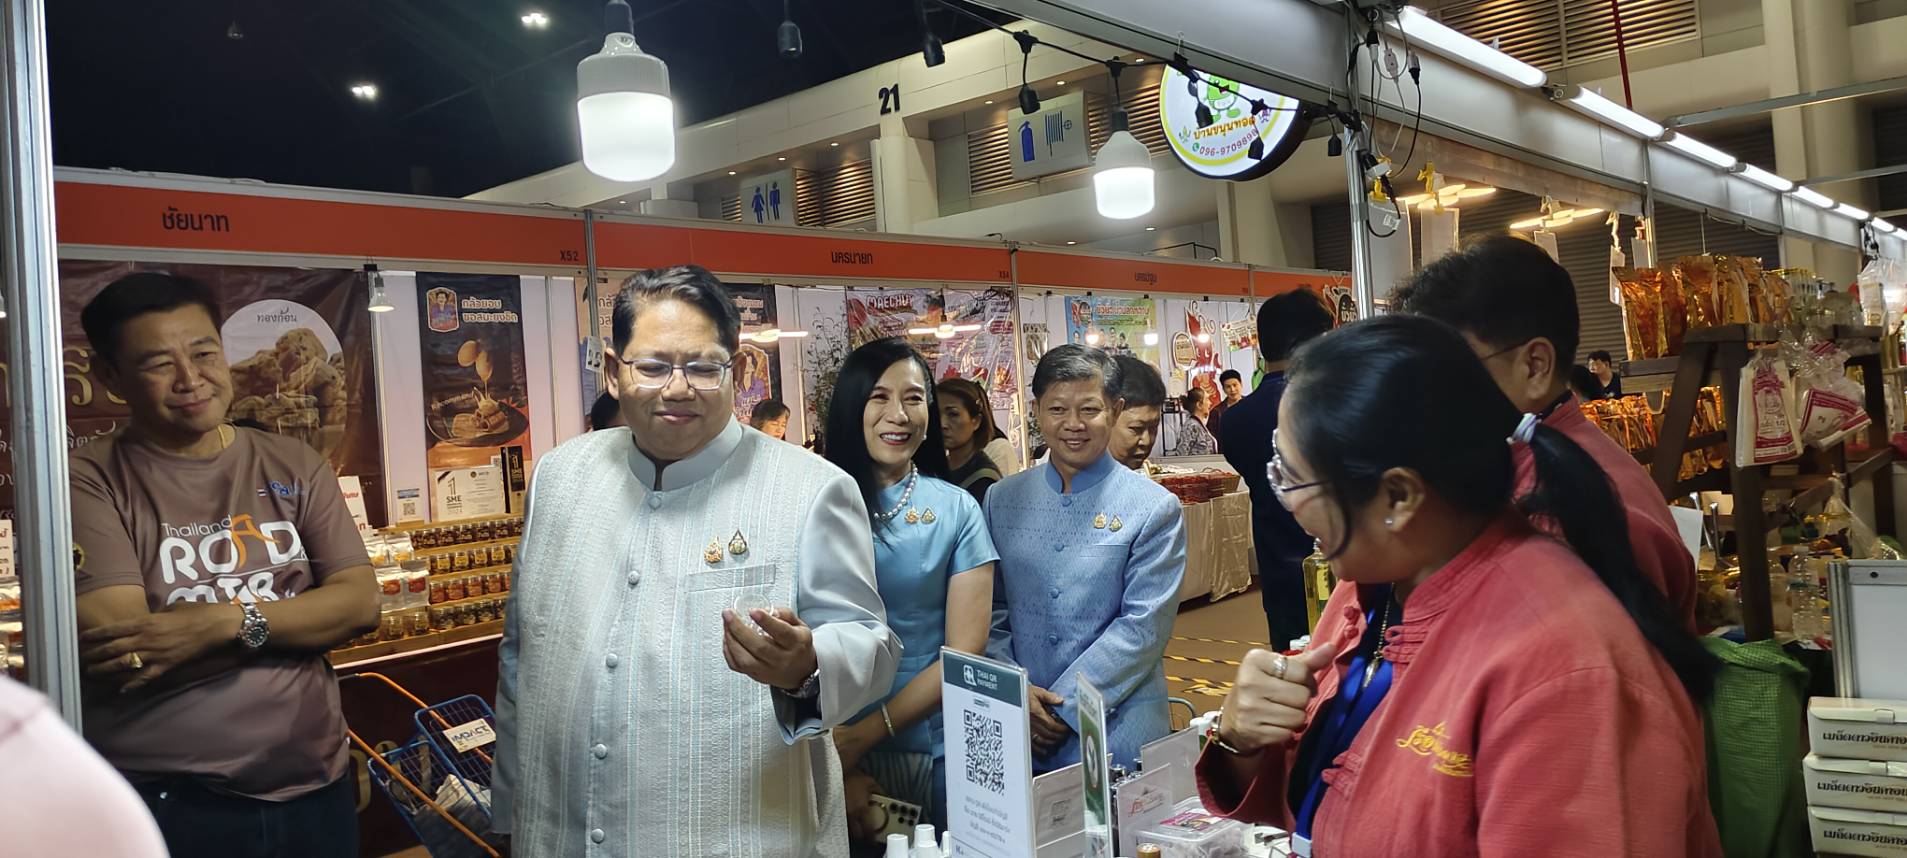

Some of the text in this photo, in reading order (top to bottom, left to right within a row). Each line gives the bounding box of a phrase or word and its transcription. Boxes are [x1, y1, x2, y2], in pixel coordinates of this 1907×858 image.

[878, 83, 900, 116] 21
[1194, 116, 1256, 140] บานขนุนทอด
[162, 206, 230, 232] ชัยนาท
[560, 250, 579, 261] X52
[831, 251, 874, 265] นครนายก
[462, 296, 502, 308] กล้วยอบ
[256, 307, 297, 322] ทองก้อน
[446, 495, 462, 503] SME
[162, 514, 234, 538] Thailand
[160, 513, 303, 584] ROAD
[976, 670, 989, 680] THAI
